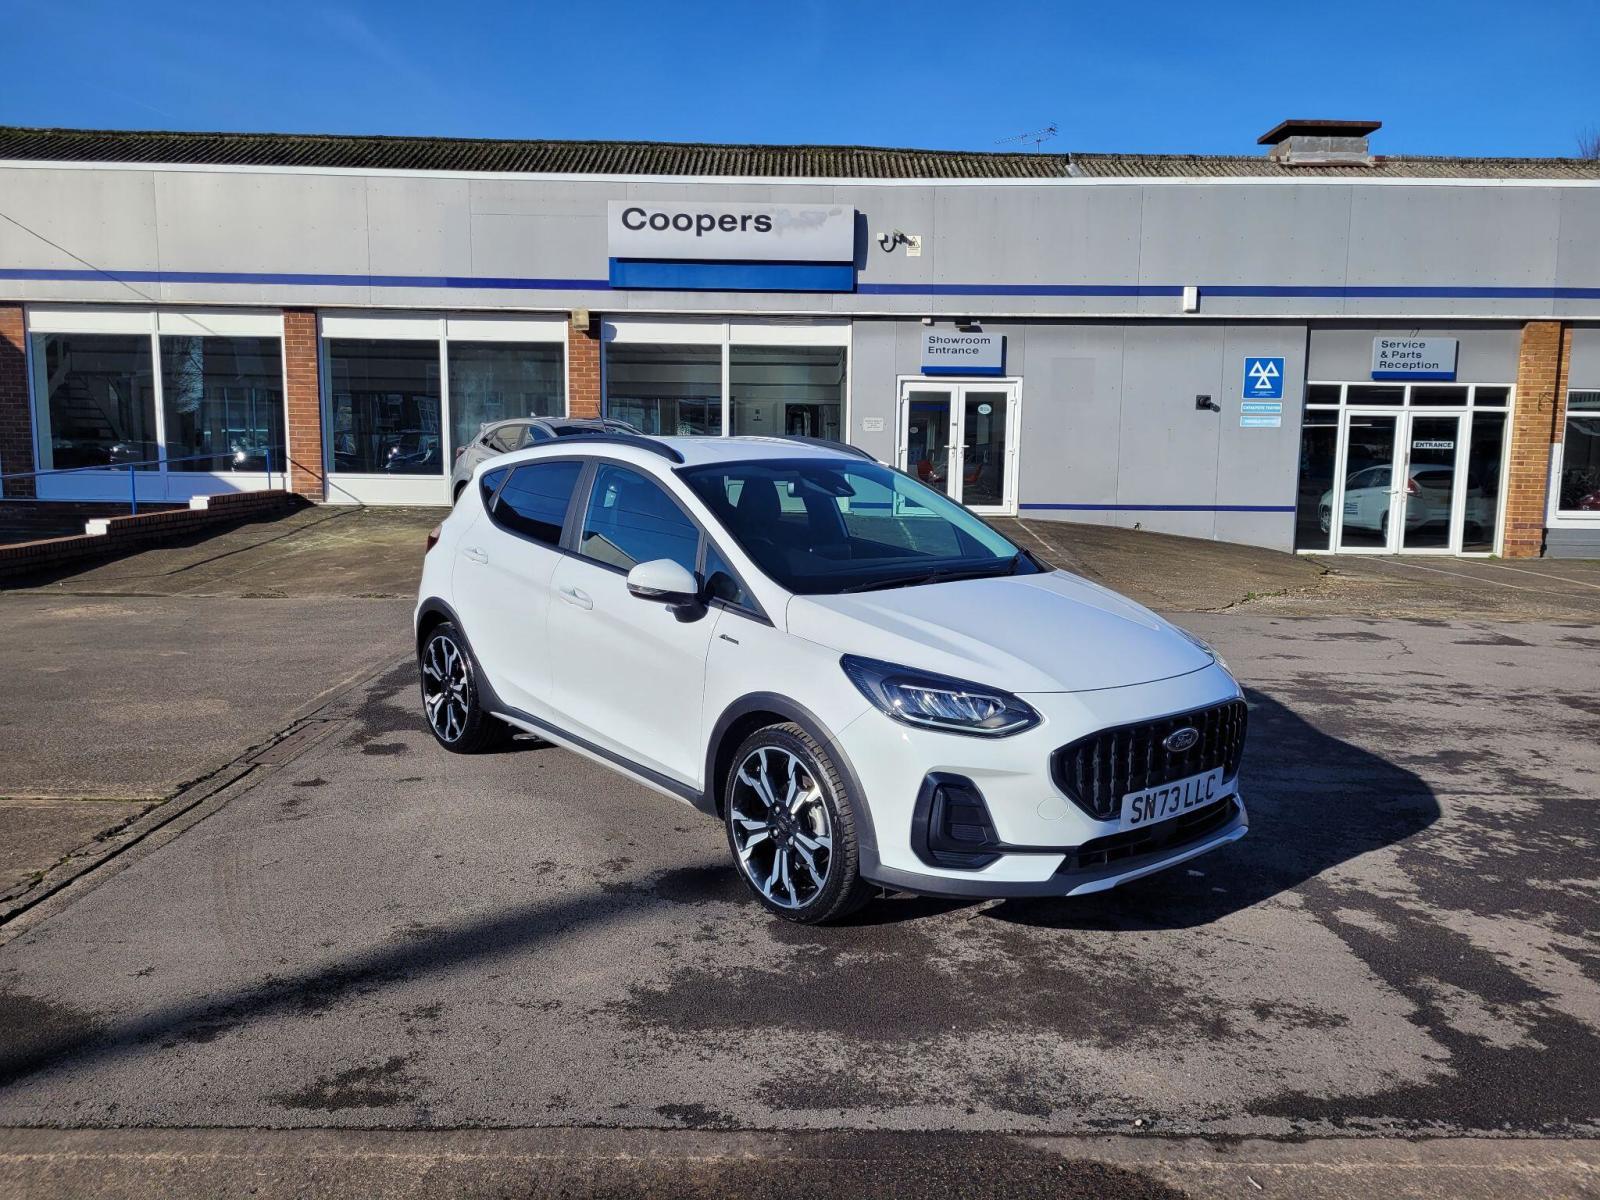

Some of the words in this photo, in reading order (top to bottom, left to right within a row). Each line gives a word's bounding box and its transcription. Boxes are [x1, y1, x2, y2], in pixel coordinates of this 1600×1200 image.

[621, 207, 773, 237] Coopers
[928, 335, 991, 345] Showroom
[1381, 340, 1426, 349] Service
[928, 346, 979, 355] Entrance
[1380, 351, 1388, 359] &
[1391, 350, 1422, 359] Parts
[1379, 360, 1439, 370] Reception
